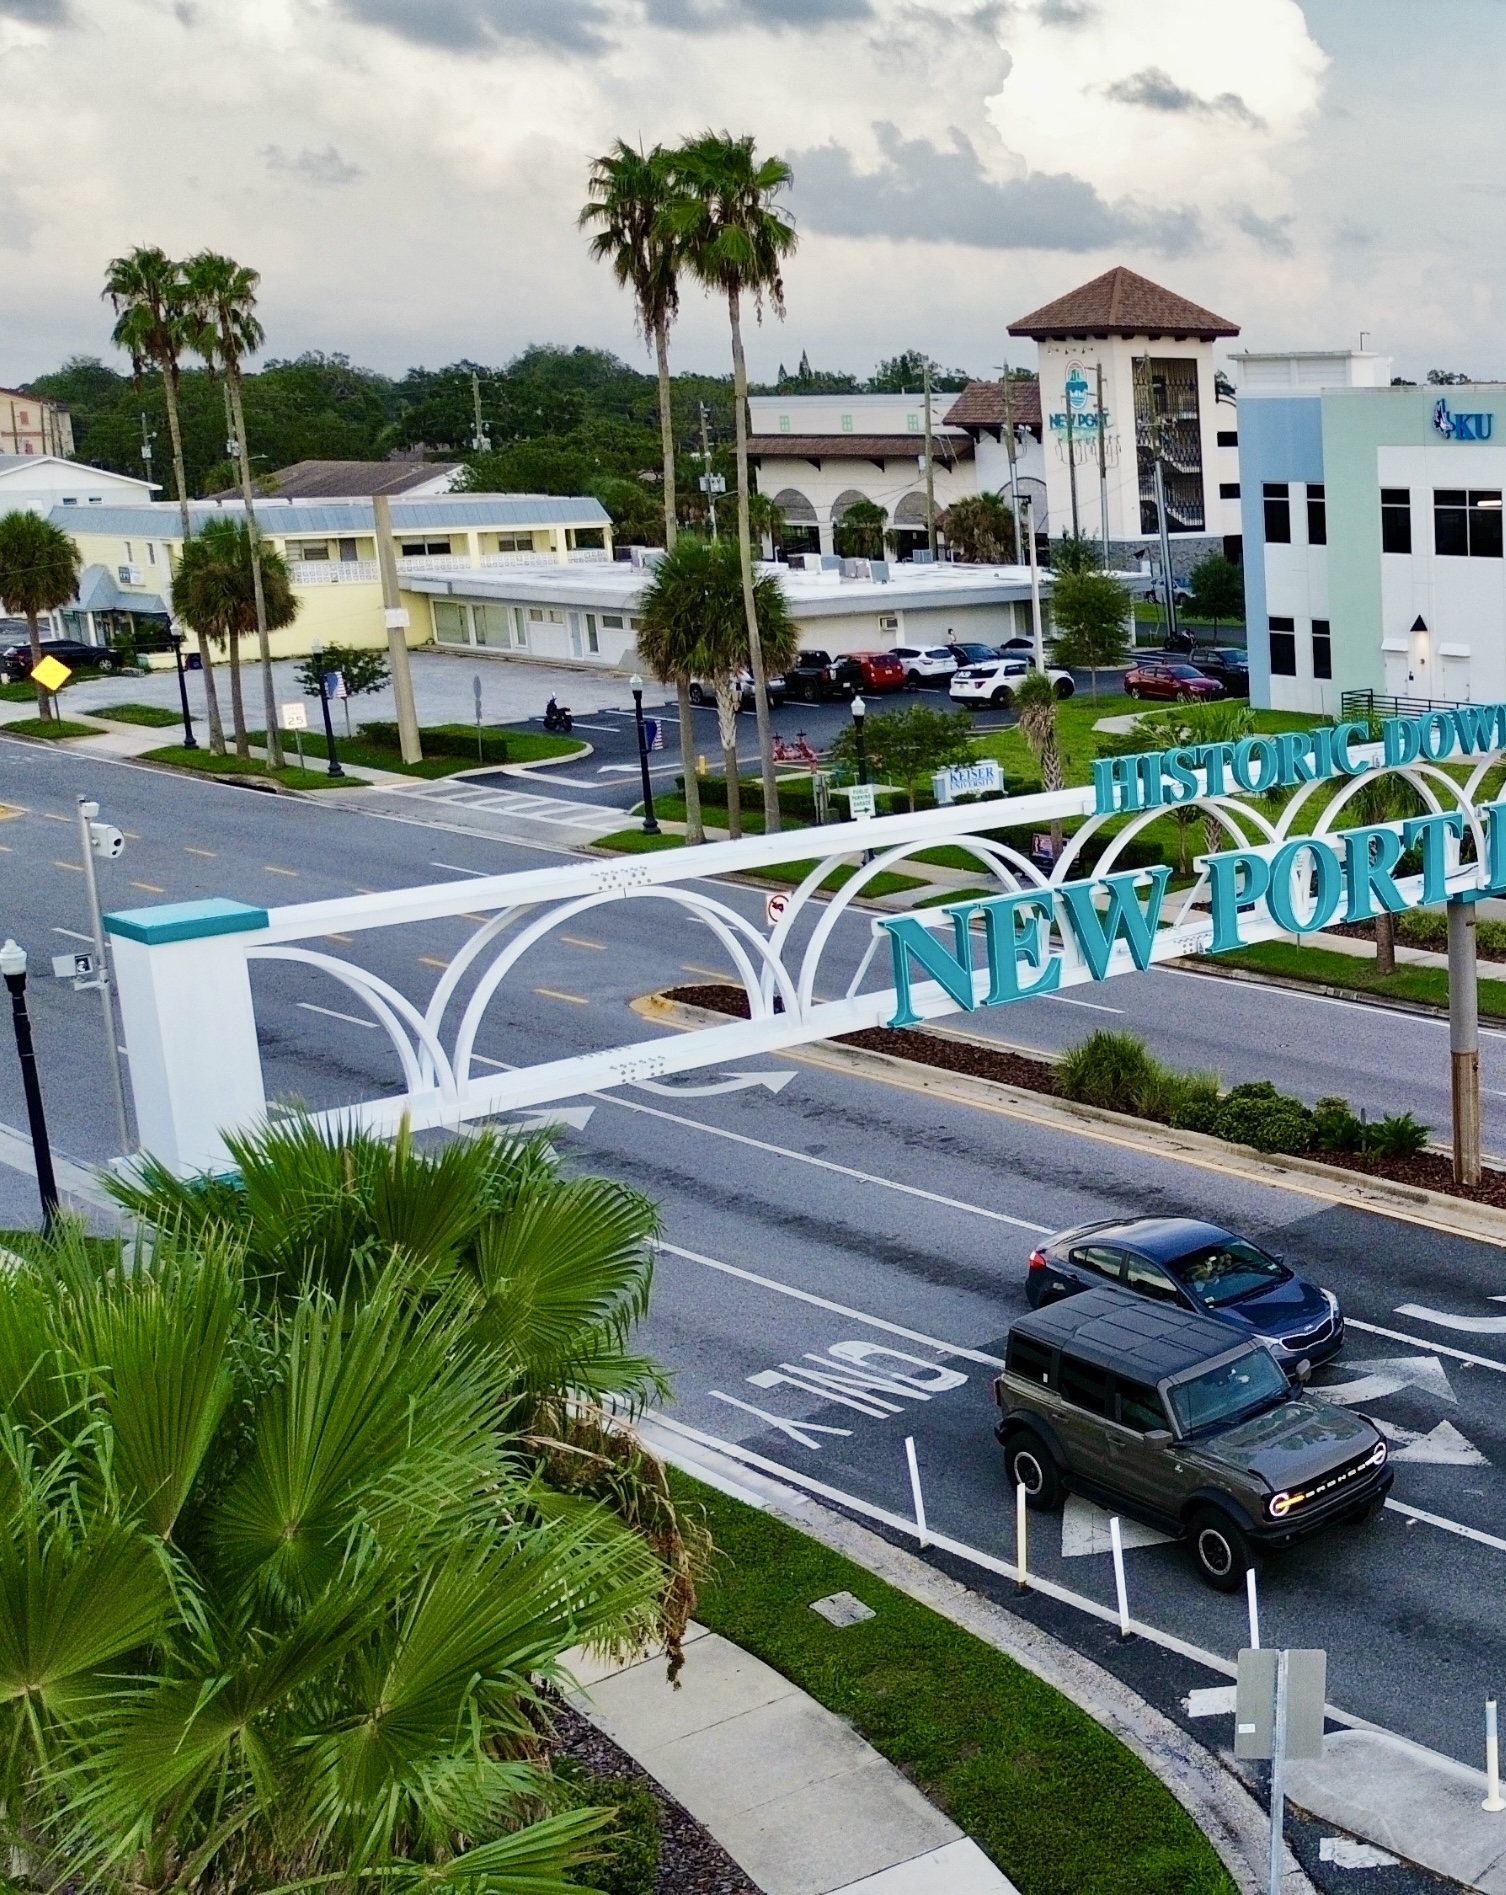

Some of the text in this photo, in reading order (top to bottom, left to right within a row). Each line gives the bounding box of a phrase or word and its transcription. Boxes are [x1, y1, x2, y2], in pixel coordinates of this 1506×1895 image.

[1454, 413, 1493, 440] KU
[287, 716, 304, 726] 25
[950, 767, 994, 784] KEISER
[1090, 721, 1370, 816] HISTORIC
[877, 866, 1174, 1029] NEW
[1200, 810, 1464, 954] PORT
[708, 1340, 970, 1450] ONLY
